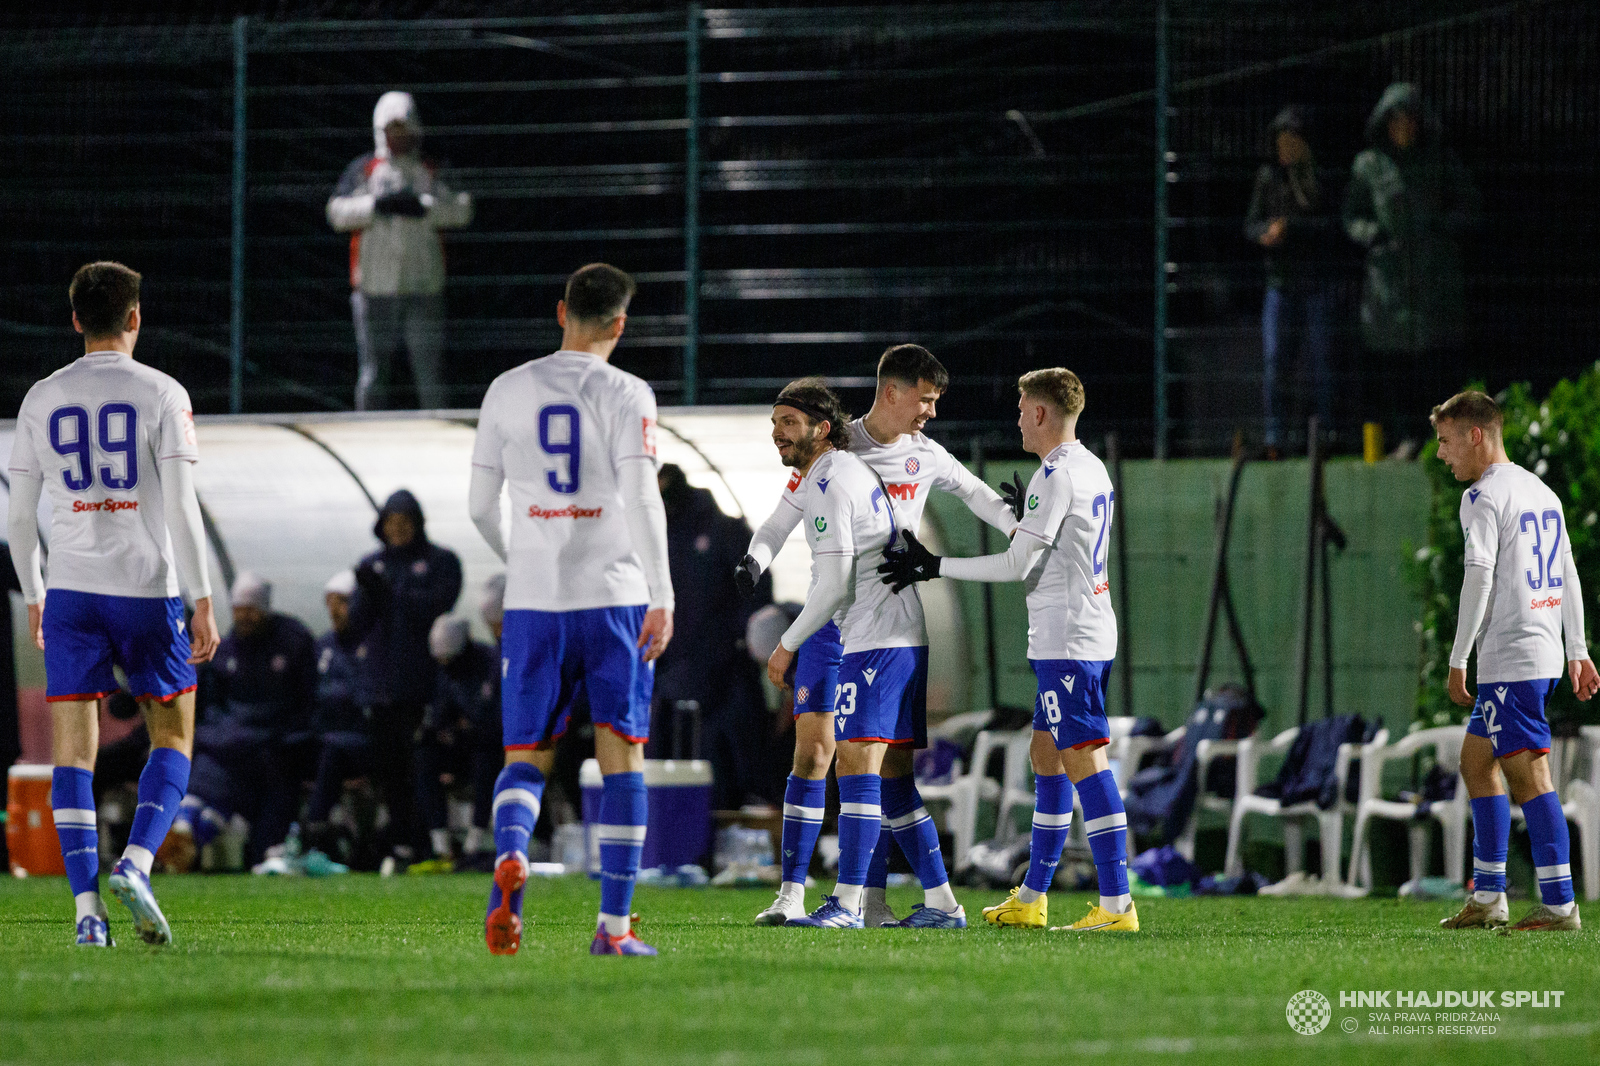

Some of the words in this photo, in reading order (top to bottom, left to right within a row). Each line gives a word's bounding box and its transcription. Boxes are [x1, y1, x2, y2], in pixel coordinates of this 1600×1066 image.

[48, 402, 140, 492] 99
[537, 403, 580, 494] 9
[528, 504, 603, 519] SuperSport
[1092, 487, 1114, 577] 2
[1519, 508, 1563, 591] 32
[833, 682, 857, 716] 23
[1040, 690, 1062, 724] 8
